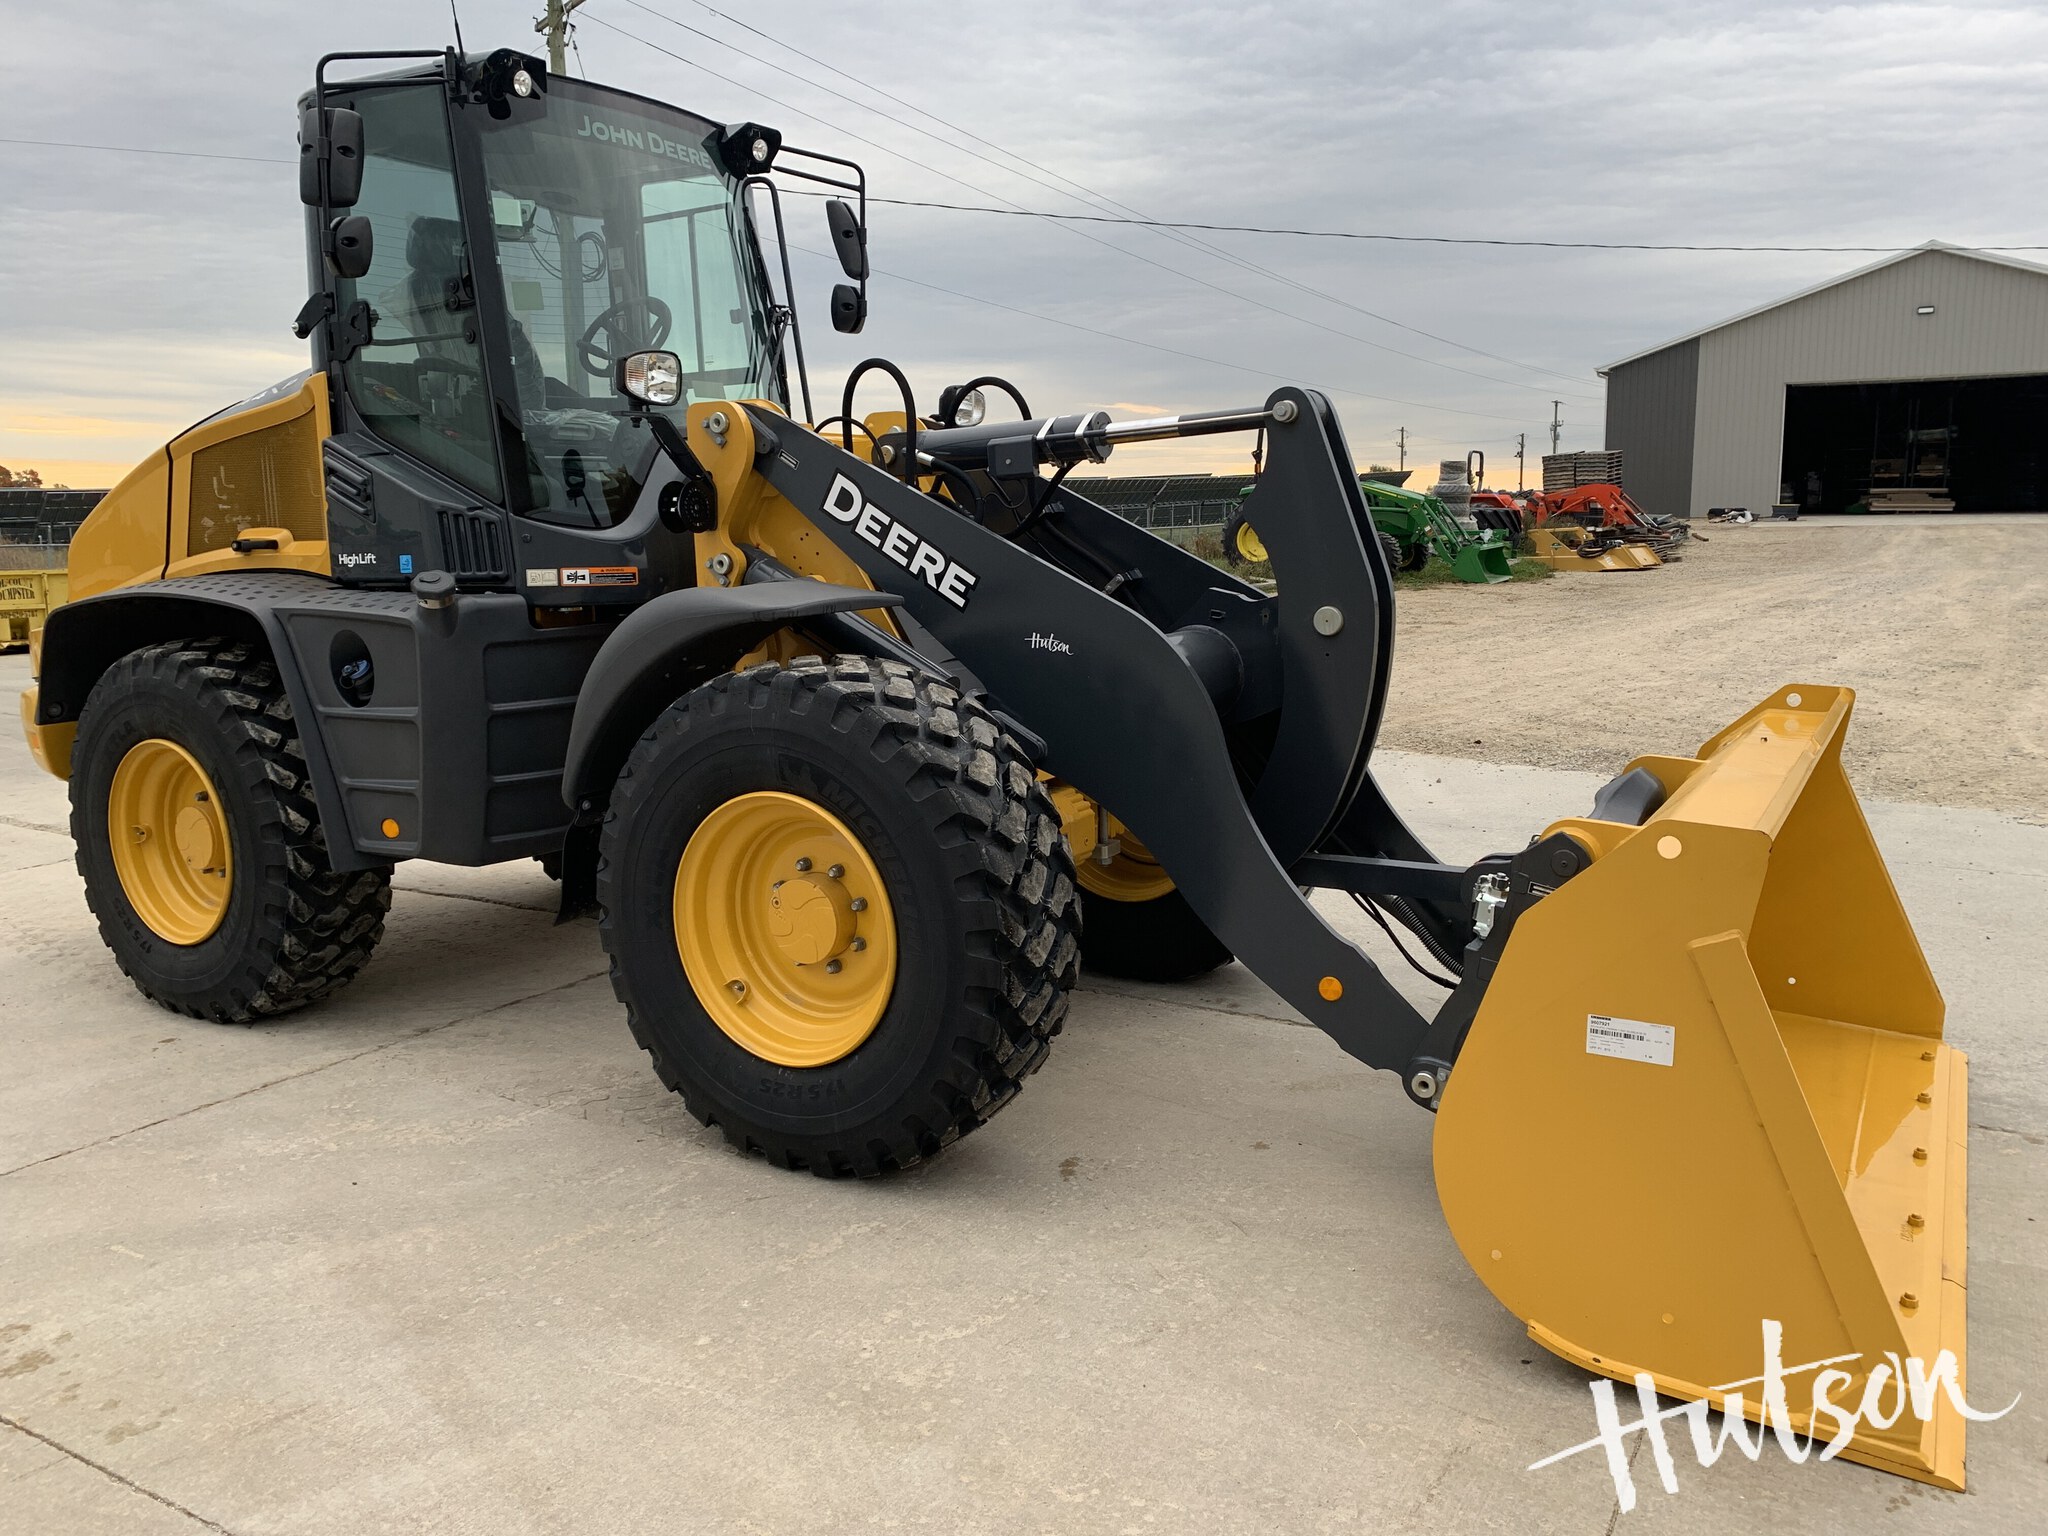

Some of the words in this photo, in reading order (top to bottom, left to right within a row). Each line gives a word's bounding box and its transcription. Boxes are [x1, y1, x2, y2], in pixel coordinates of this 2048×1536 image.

[577, 115, 644, 149] JOHN
[647, 131, 712, 169] DEERE
[823, 473, 976, 607] DEERE
[1023, 632, 1074, 655] Hutson
